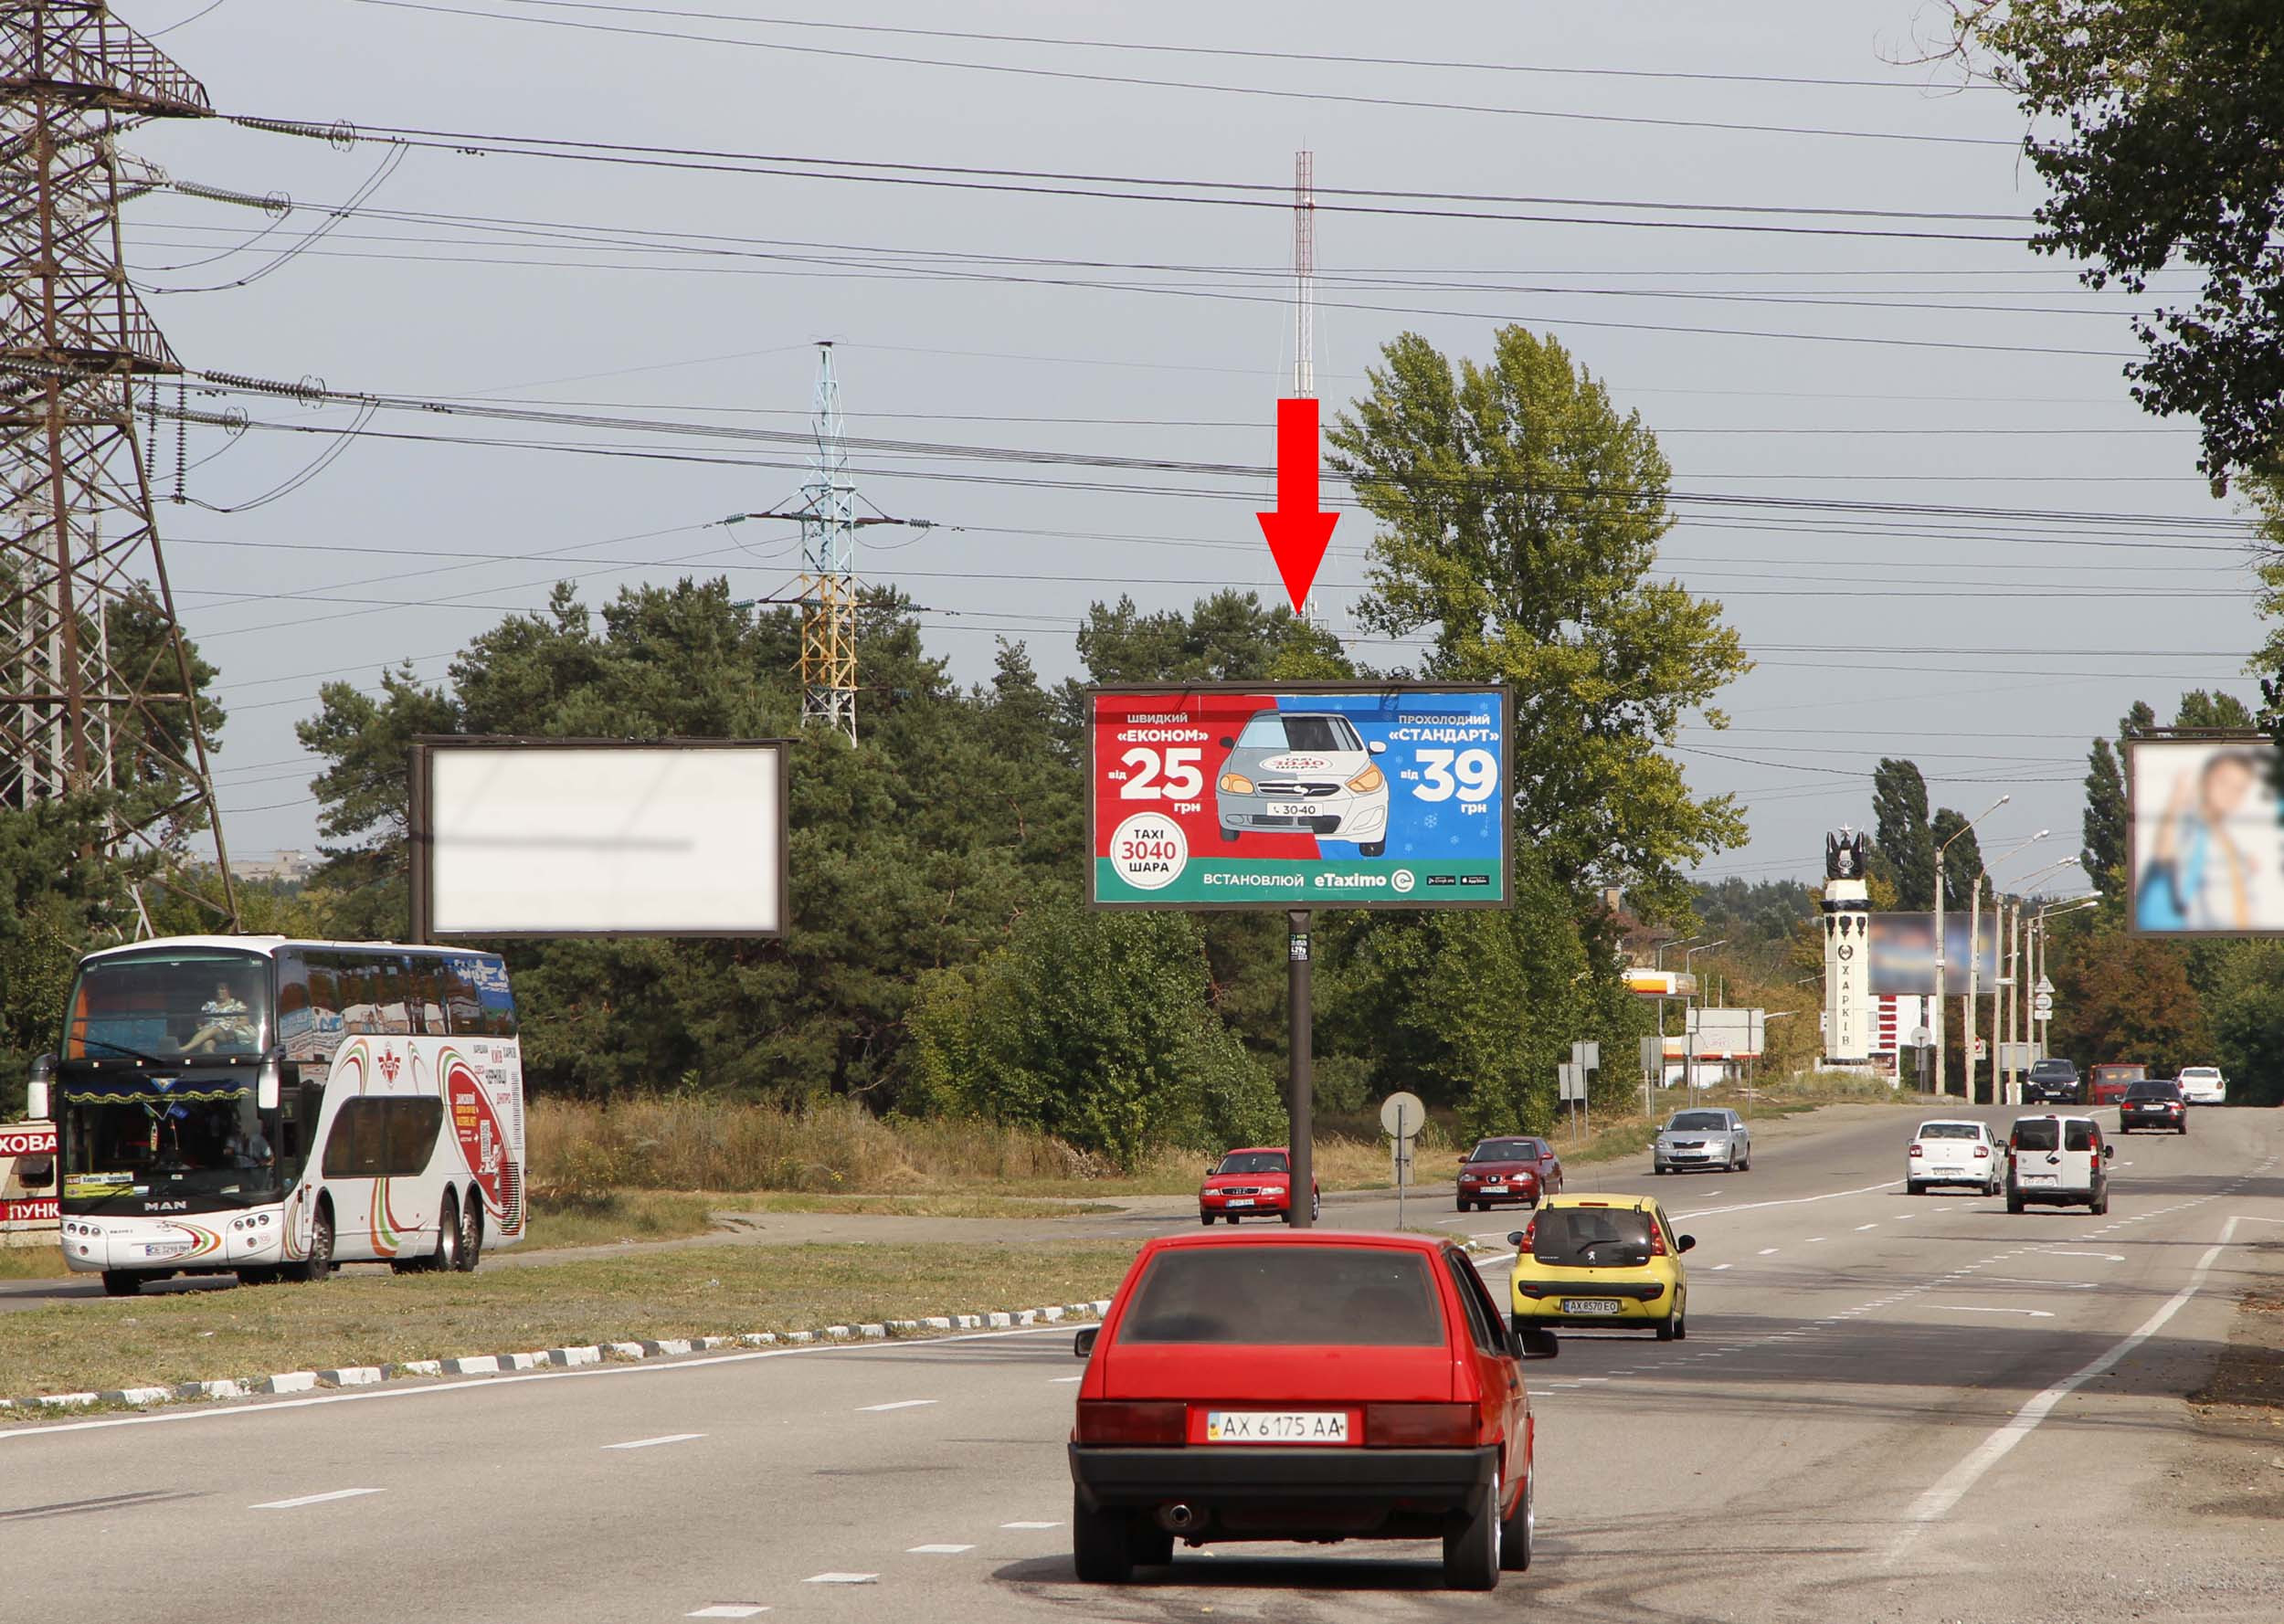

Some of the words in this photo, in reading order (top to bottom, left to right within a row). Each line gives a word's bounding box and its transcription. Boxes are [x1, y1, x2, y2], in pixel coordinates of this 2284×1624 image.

[1126, 712, 1188, 724] ШВИДКИЙ
[1399, 714, 1490, 726] ПРОХОЛОДНИЙ
[1116, 729, 1209, 742] «ЕКОНОМ»
[1389, 728, 1499, 743] «СТАНДАРТ»
[1108, 770, 1126, 780] від
[1120, 747, 1203, 800] 25
[1401, 769, 1418, 780] від
[1412, 749, 1497, 802] 39
[1174, 803, 1200, 815] грн
[1283, 805, 1316, 815] 30-40
[1461, 804, 1486, 815] грн
[1134, 829, 1164, 839] TAXI
[1122, 841, 1176, 859] 3040
[1129, 862, 1169, 872] ШАРА
[1203, 873, 1304, 887] ВСТАНОВЛЮЙ
[1315, 873, 1387, 887] eTaximo
[1842, 966, 1850, 1045] ХАРКІВ
[144, 1201, 187, 1211] MAN
[1571, 1301, 1581, 1310] AX
[1223, 1417, 1250, 1436] AX
[1259, 1417, 1305, 1436] 6175
[1314, 1417, 1340, 1436] AA
